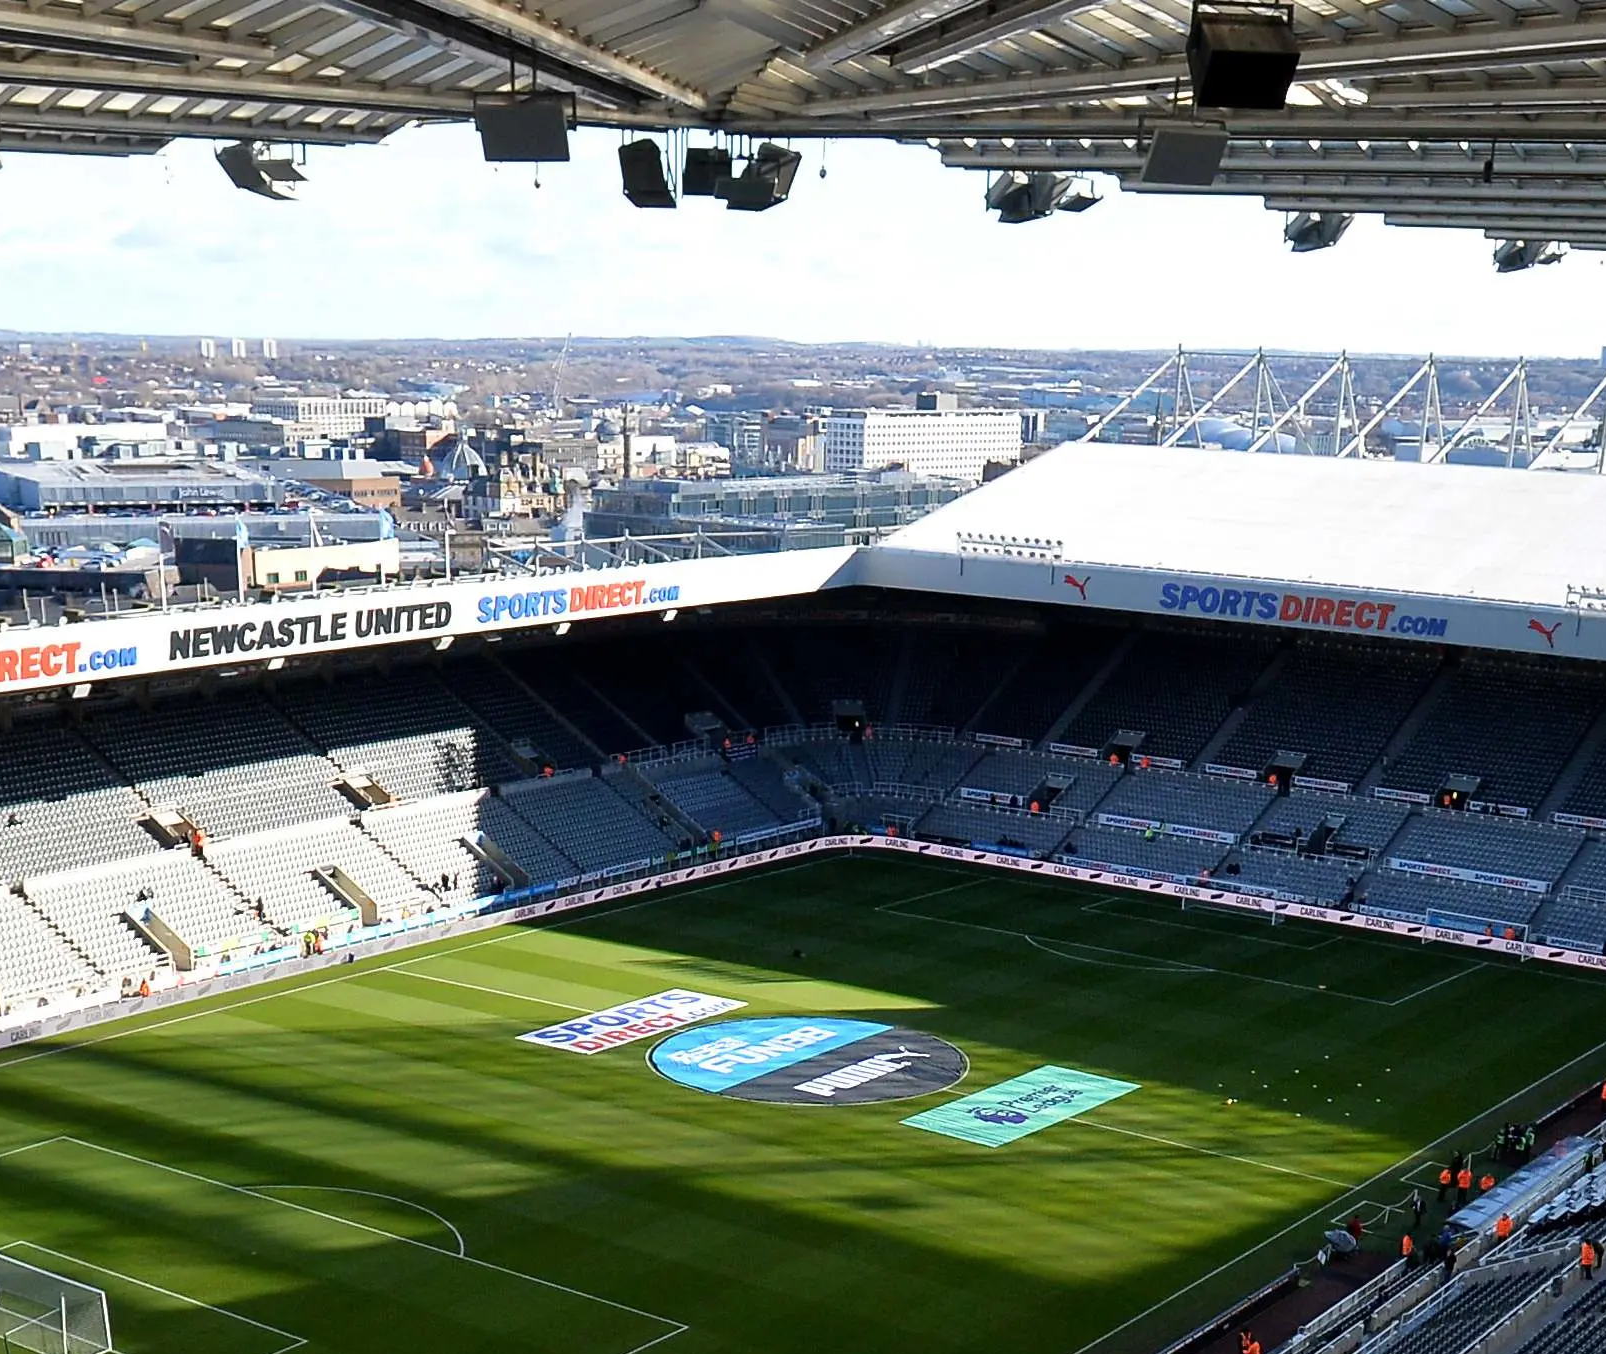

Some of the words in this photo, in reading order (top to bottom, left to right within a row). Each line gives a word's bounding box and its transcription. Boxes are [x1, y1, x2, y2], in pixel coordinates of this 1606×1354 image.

[179, 487, 199, 499] John
[169, 612, 347, 661] NEWCASTLE
[355, 601, 452, 638] UNITED
[885, 838, 909, 849] CARLING
[1300, 907, 1328, 919] CARLING
[1366, 917, 1395, 930] CARLING
[1435, 929, 1465, 942] CARLING
[535, 993, 701, 1044] SPORTS
[698, 1025, 838, 1074] FUN88
[997, 1085, 1062, 1109] Premier
[1021, 1089, 1083, 1113] League
